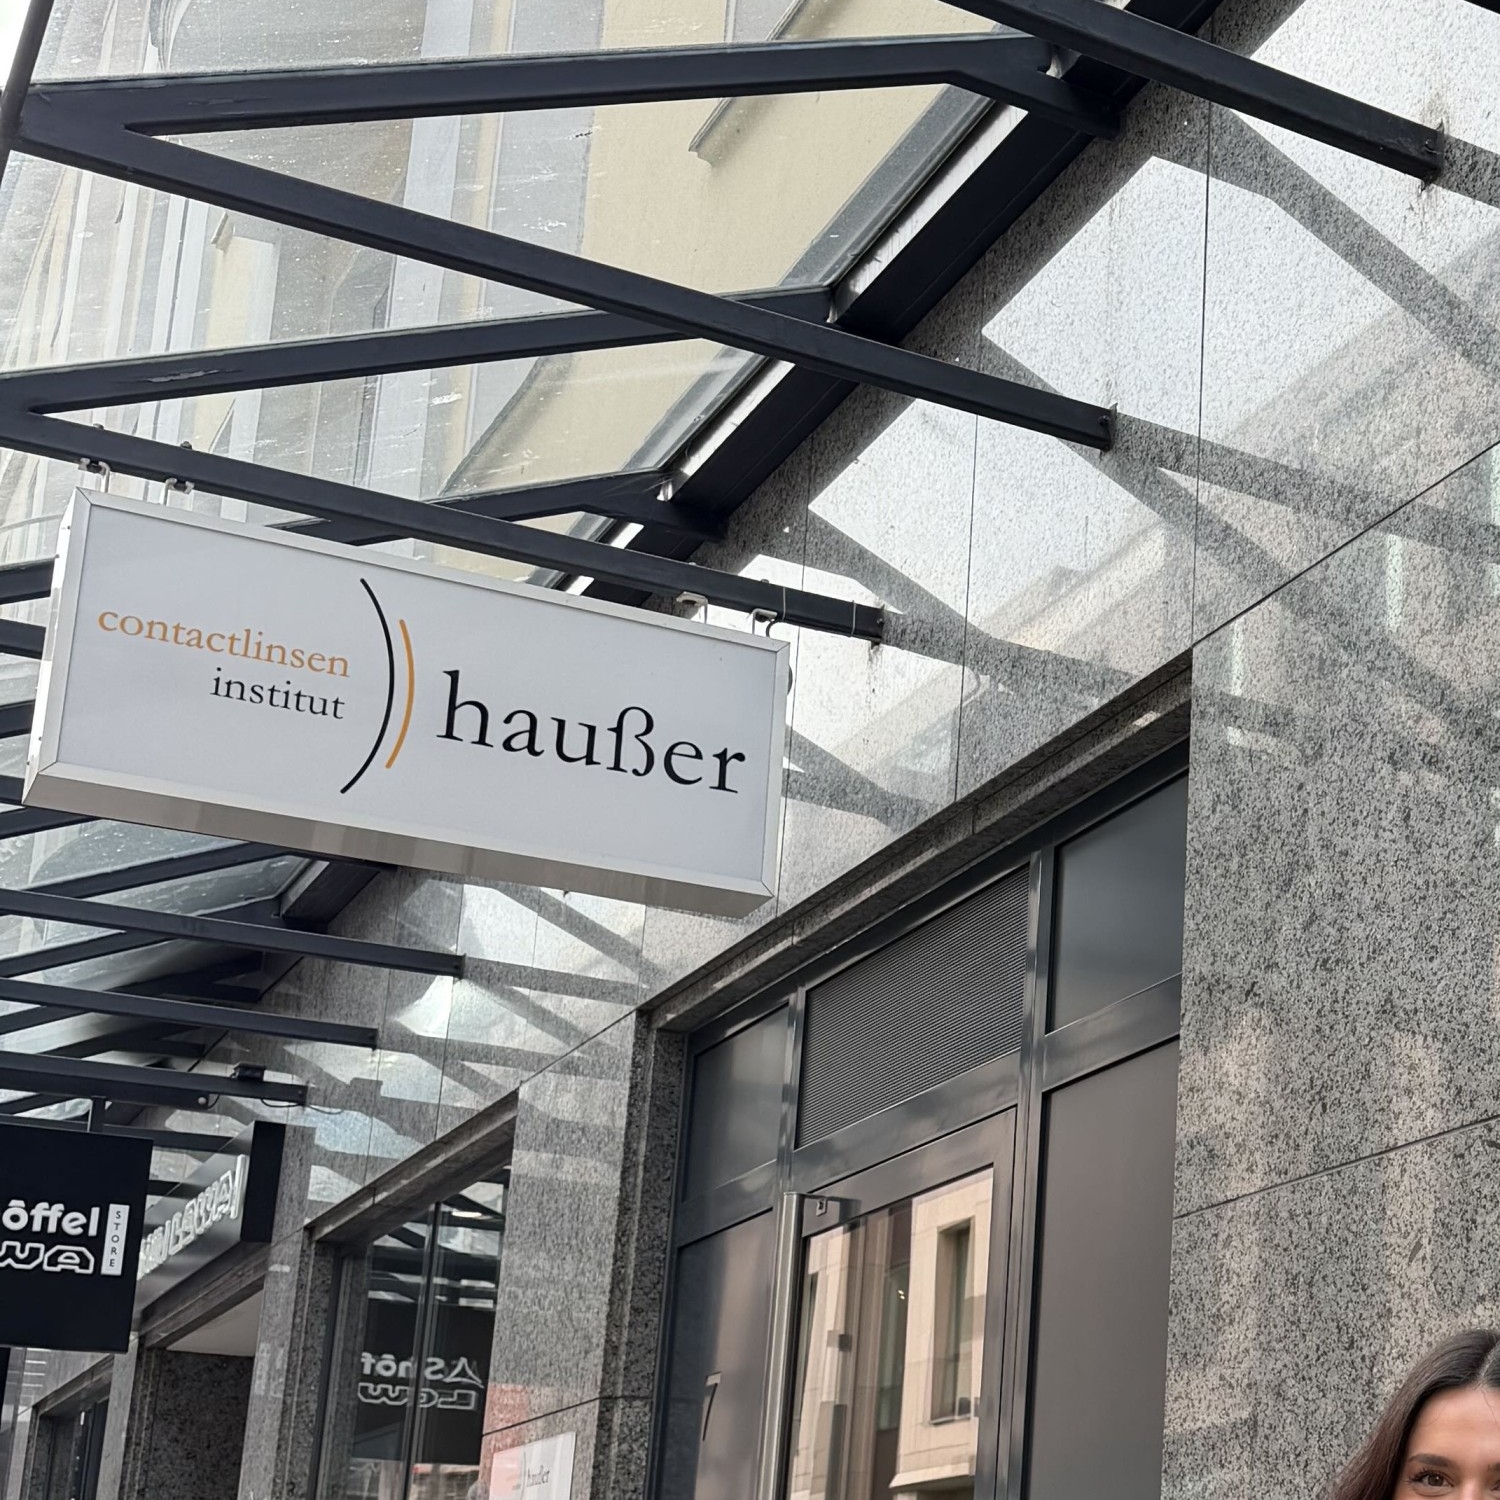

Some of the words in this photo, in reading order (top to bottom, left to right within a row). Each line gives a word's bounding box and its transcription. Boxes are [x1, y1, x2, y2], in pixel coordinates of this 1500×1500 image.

[97, 608, 351, 680] contactlinsen
[209, 667, 346, 721] institut
[435, 669, 746, 796] haußer
[109, 1210, 122, 1268] STORE
